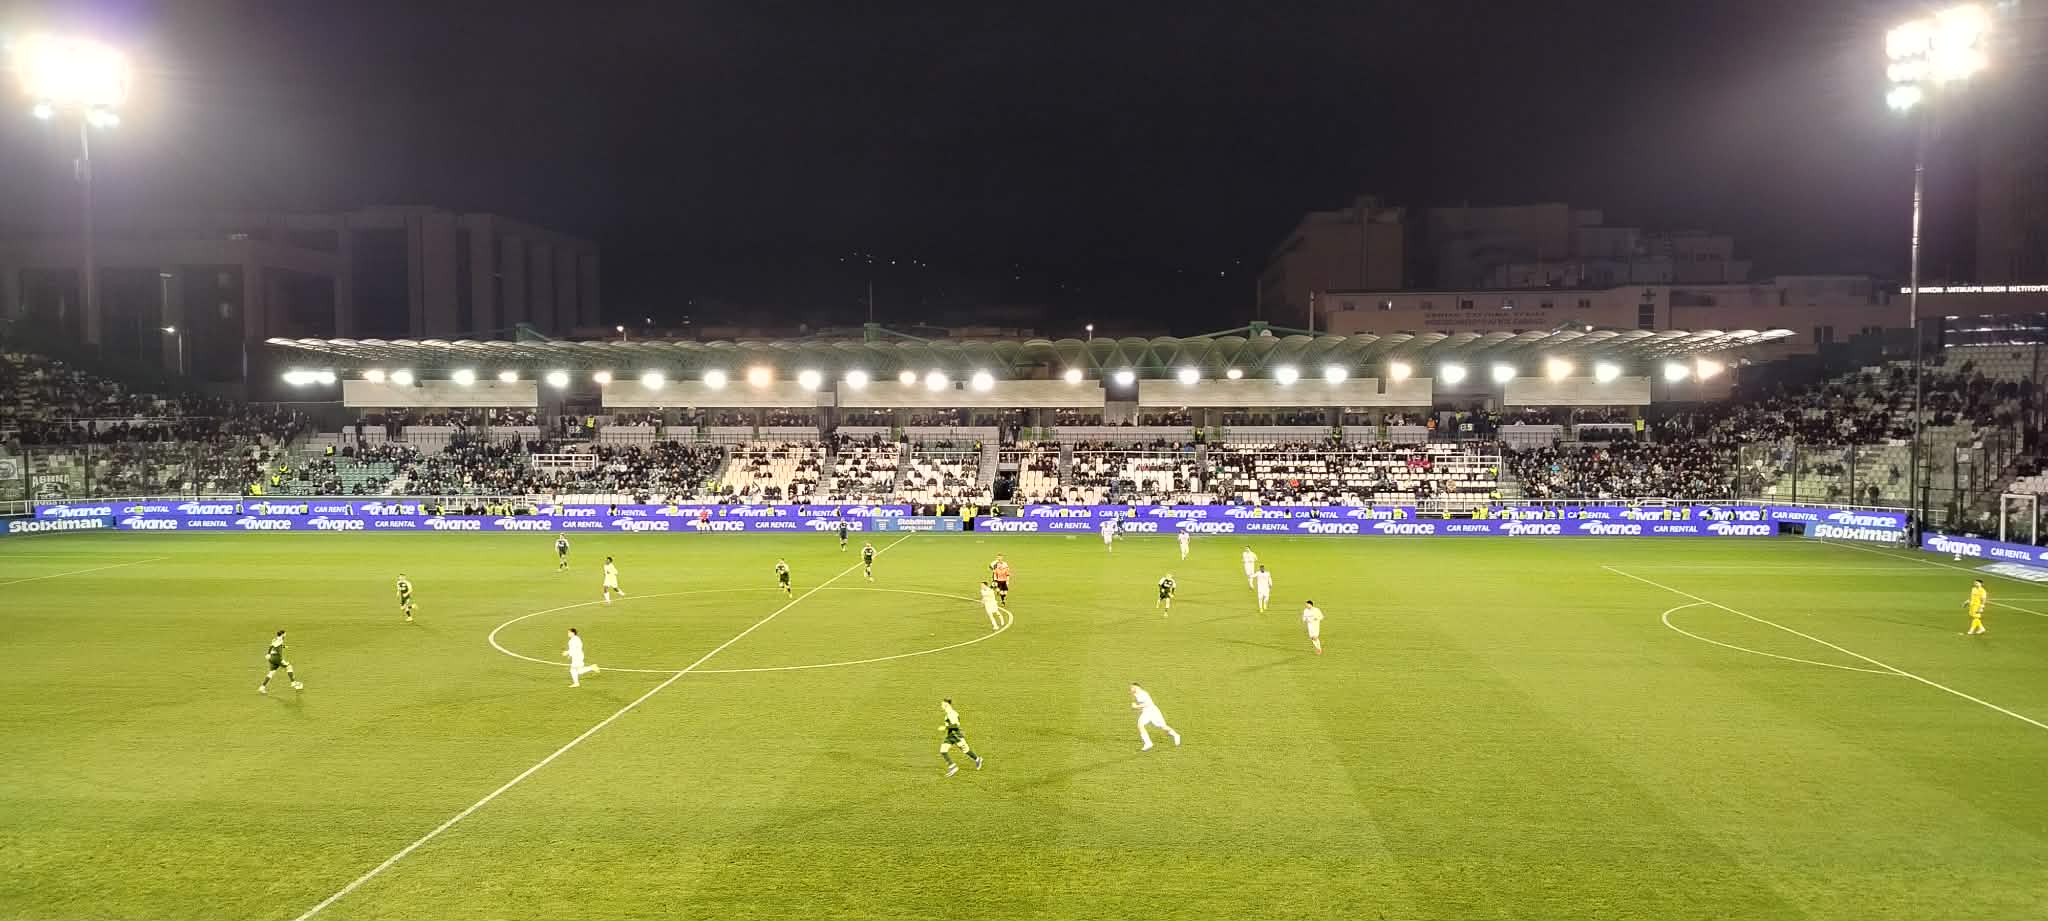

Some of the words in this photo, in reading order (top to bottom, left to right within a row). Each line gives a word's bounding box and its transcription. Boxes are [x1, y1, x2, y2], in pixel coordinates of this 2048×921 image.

[58, 506, 112, 517] avance
[186, 503, 234, 515] avance
[857, 508, 905, 516] avnce
[1159, 509, 1208, 518] aance
[1234, 509, 1284, 518] avnce
[1772, 511, 1787, 519] CAR
[1788, 512, 1818, 521] RENTAL
[1838, 514, 1897, 527] avance
[8, 518, 103, 533] Stoiximan
[131, 518, 178, 530] avance
[244, 518, 291, 530] avance
[317, 518, 364, 531] avance
[375, 520, 389, 528] CAR
[390, 520, 416, 528] RENTAL
[433, 518, 481, 530] avance
[503, 519, 552, 530] avance
[621, 519, 669, 531] avance
[755, 521, 769, 529] CAR
[770, 521, 797, 529] RENTAL
[815, 519, 863, 531] avace
[990, 520, 1038, 532] avance
[1185, 521, 1235, 532] avance
[1246, 523, 1261, 531] CAR
[1261, 523, 1289, 531] RENTAL
[1308, 521, 1360, 533] avance
[1383, 522, 1435, 534] avance
[1446, 524, 1461, 532] CAR
[1462, 524, 1490, 532] RENTAL
[1508, 522, 1561, 535] avance
[1590, 522, 1642, 535] avance
[1653, 525, 1669, 533] CAR
[1669, 525, 1698, 533] RENTAL
[1717, 523, 1770, 535] avance
[1936, 539, 1982, 557] avance
[1991, 548, 2005, 557] CAR
[2005, 549, 2032, 561] RENTAL
